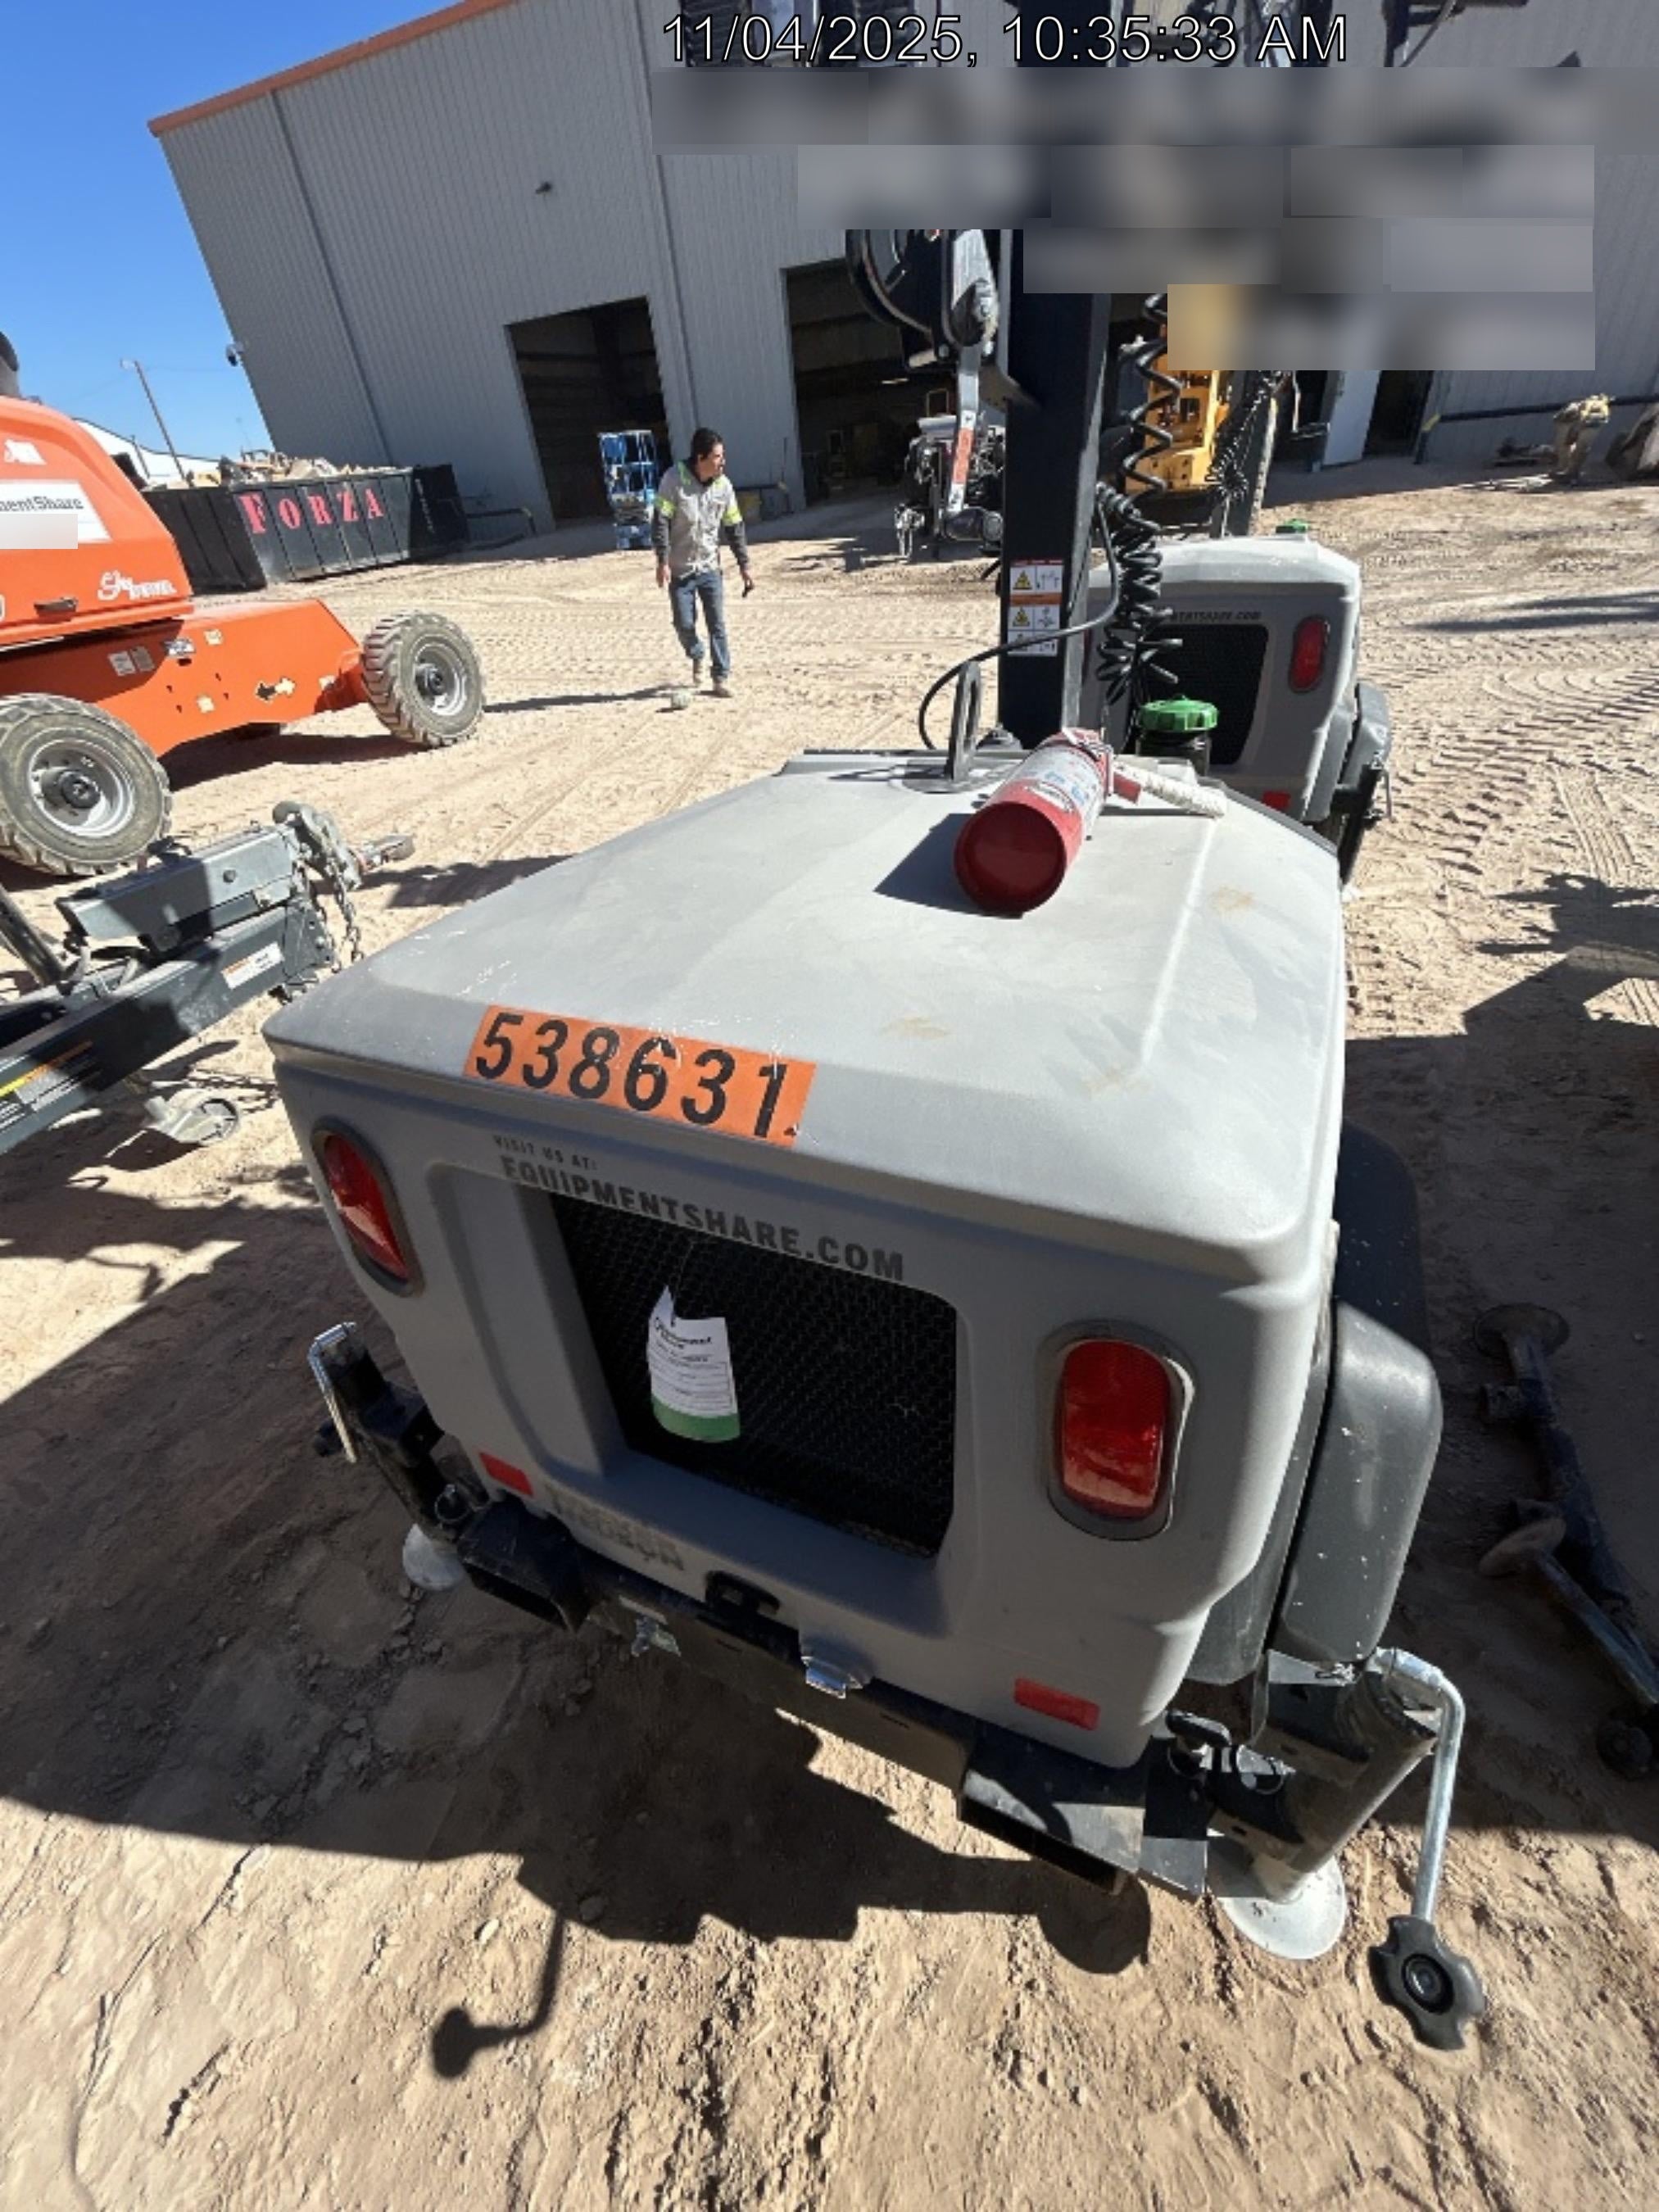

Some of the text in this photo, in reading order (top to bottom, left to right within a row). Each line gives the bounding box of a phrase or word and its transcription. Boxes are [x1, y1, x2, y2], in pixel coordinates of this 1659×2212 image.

[475, 1011, 789, 1138] 538631
[492, 1134, 598, 1171] VISIT US AT:
[502, 1155, 902, 1281] EQUIPMENTSHARE.COM
